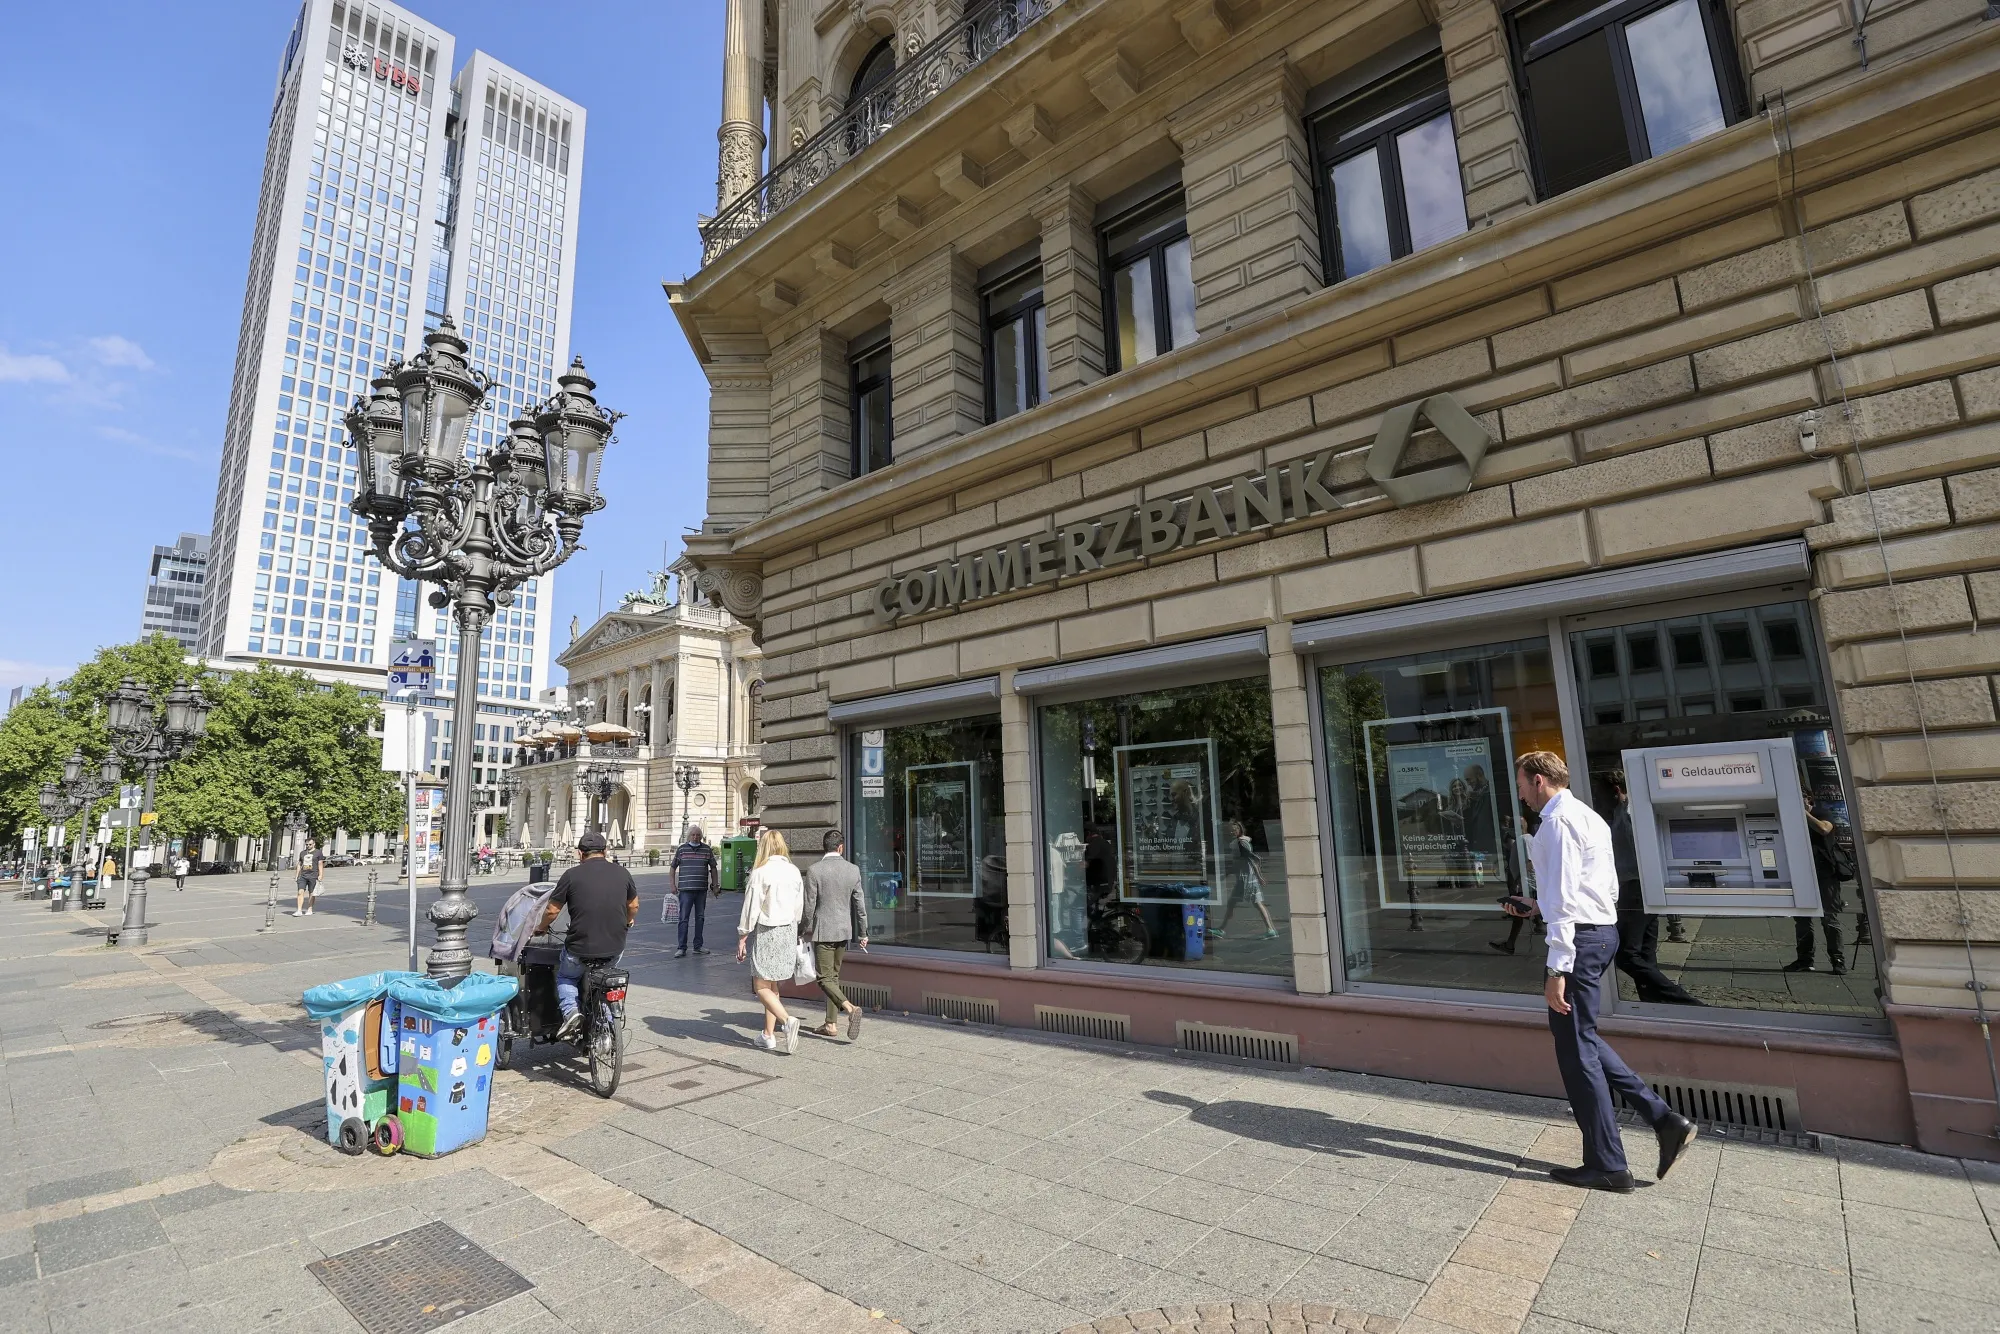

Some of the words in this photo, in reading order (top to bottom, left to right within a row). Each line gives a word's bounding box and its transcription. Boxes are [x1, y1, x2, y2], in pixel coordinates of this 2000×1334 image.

[374, 57, 420, 93] UBS
[873, 449, 1345, 623] COMMERZBANK
[1681, 764, 1757, 777] Geldautomat
[1178, 836, 1193, 844] geht
[1402, 834, 1426, 842] Keine
[1427, 833, 1445, 841] Zeit
[1162, 843, 1186, 851] Überall.
[1403, 843, 1457, 851] Vergleichen?
